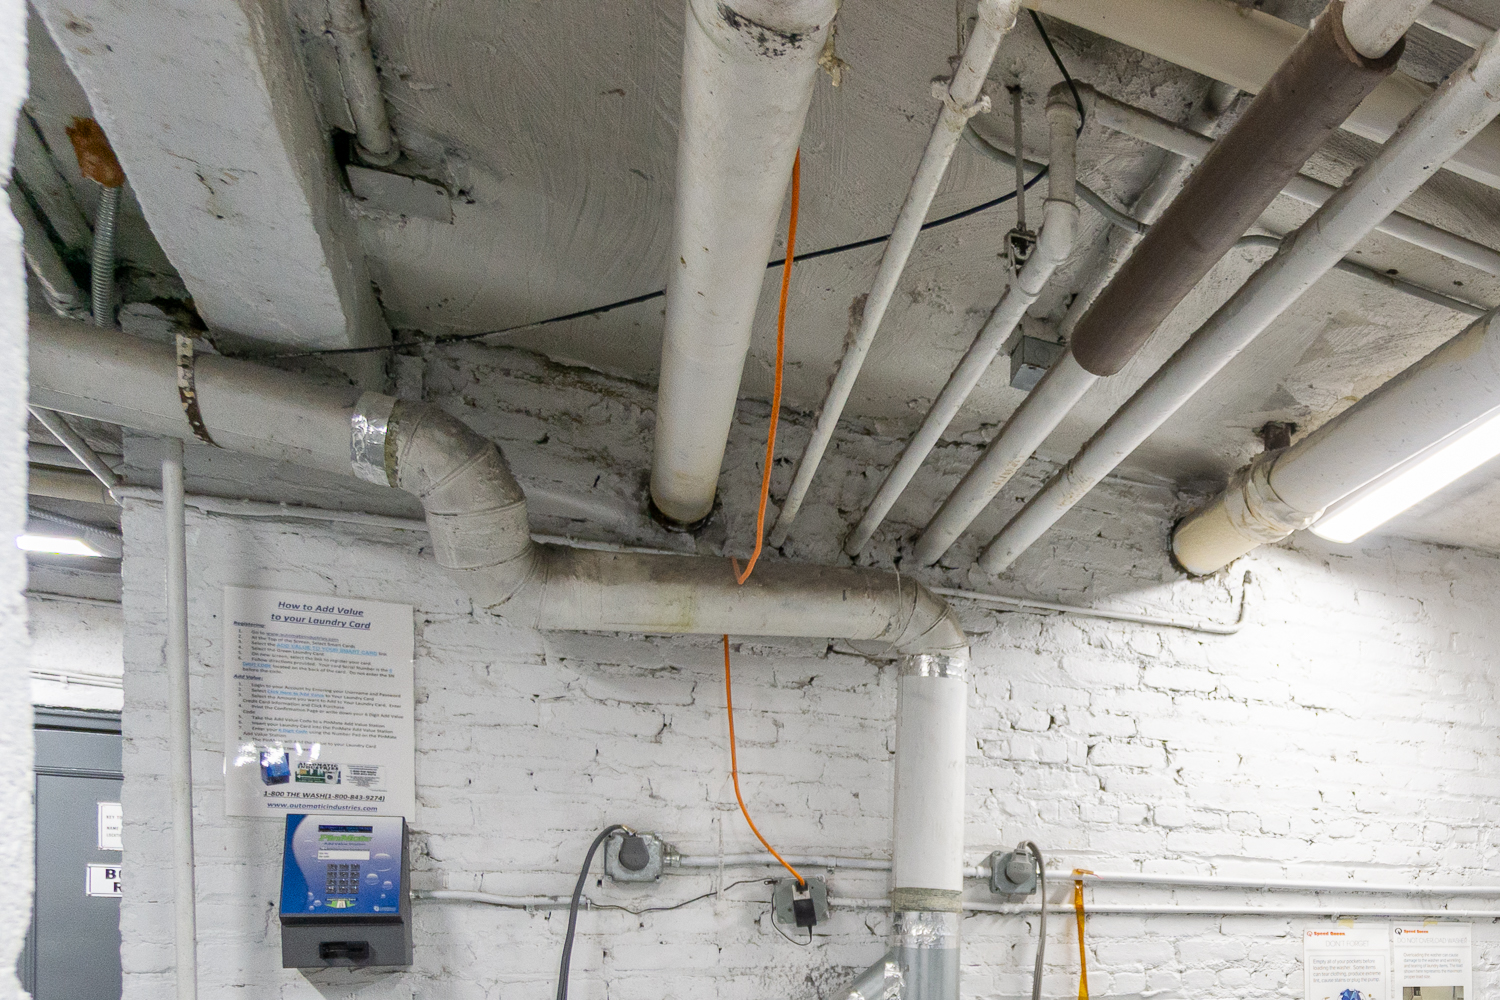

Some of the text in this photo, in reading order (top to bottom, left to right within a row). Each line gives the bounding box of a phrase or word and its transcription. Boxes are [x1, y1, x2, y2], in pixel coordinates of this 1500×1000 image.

[278, 601, 364, 616] How to Add Value
[271, 614, 372, 630] to your Laundry Card
[302, 792, 386, 802] WASH(1-800-843-9274)
[267, 802, 378, 812] www.automaticindustries.com
